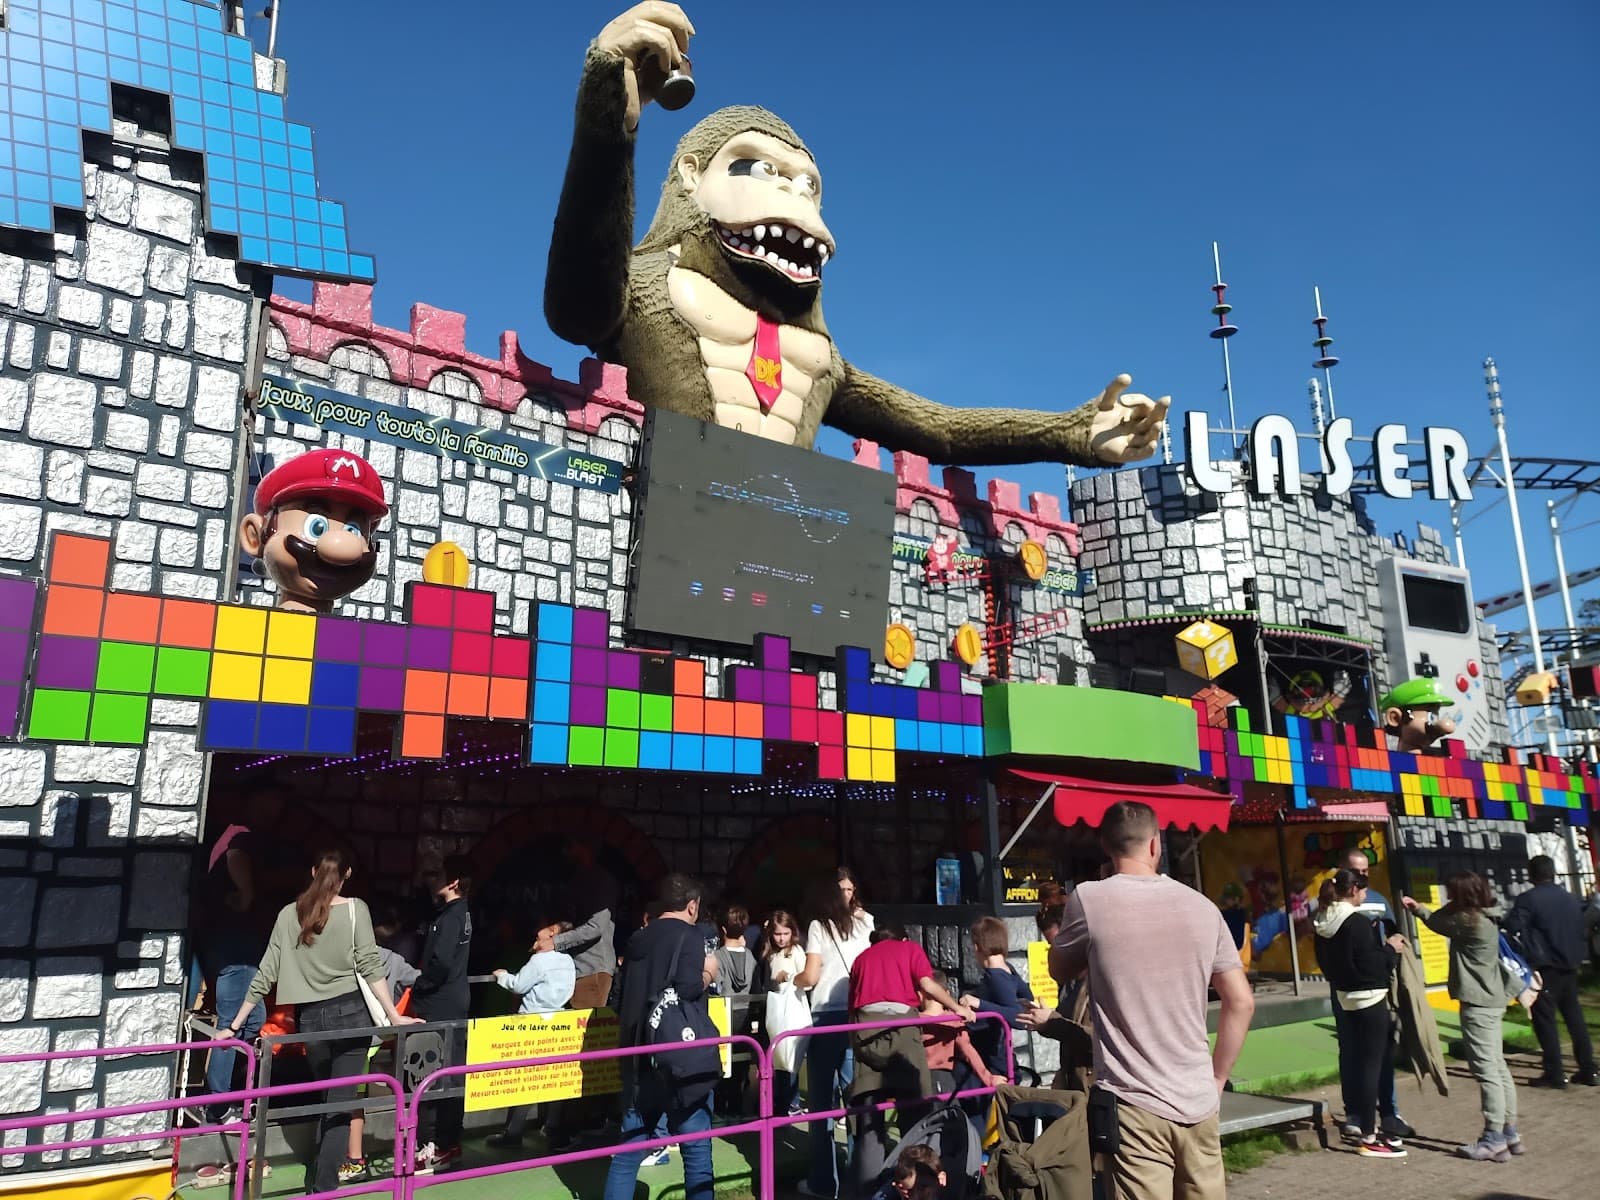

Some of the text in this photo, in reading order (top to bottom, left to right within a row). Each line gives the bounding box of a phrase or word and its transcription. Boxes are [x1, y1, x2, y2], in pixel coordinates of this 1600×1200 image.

[754, 356, 781, 389] DK
[257, 380, 529, 468] jeux pour toute la famille
[1185, 410, 1474, 501] LASER
[491, 1041, 521, 1050] Marquez
[537, 1038, 558, 1046] points
[501, 1023, 571, 1032] Jeu de laser game
